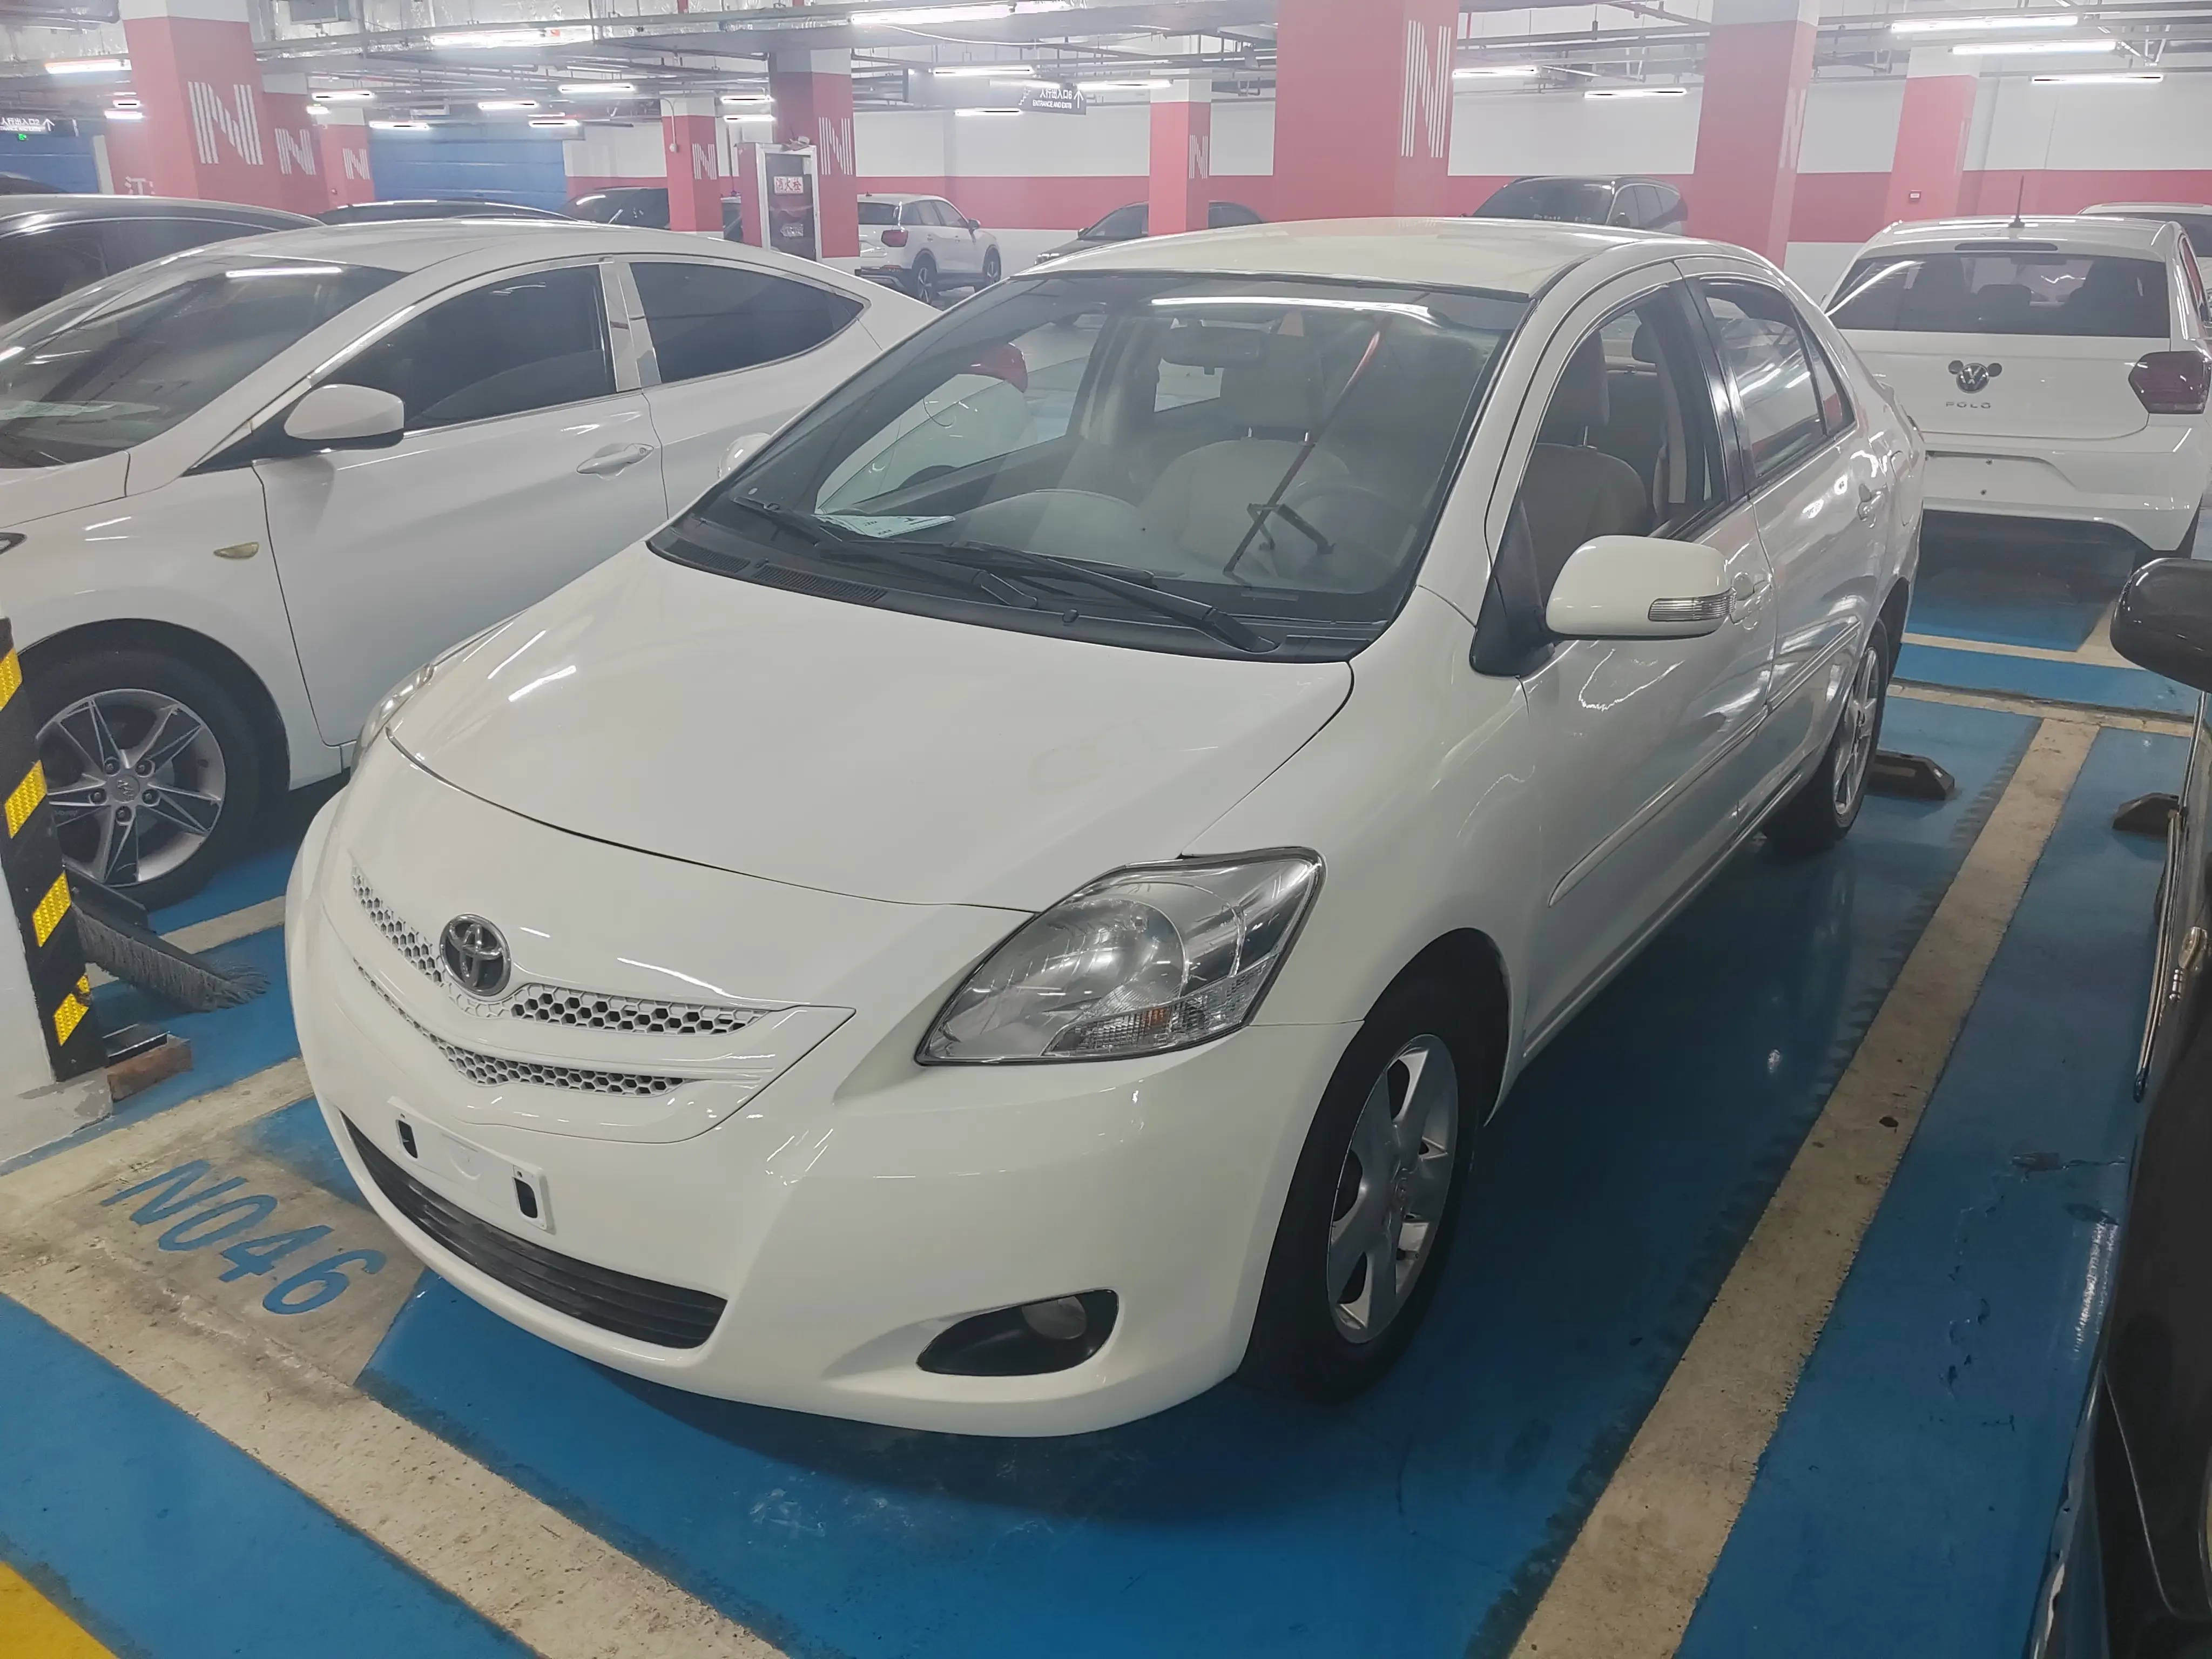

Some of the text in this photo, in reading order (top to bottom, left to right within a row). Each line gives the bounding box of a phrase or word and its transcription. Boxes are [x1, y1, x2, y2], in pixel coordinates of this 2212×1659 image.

[1401, 20, 1451, 158] N
[188, 82, 263, 165] N
[819, 117, 853, 175] N
[274, 128, 316, 175] N
[342, 149, 370, 179] N
[692, 143, 717, 180] N
[1189, 134, 1208, 179] N
[775, 178, 801, 192] 消火栓
[100, 1159, 387, 1315] N046
